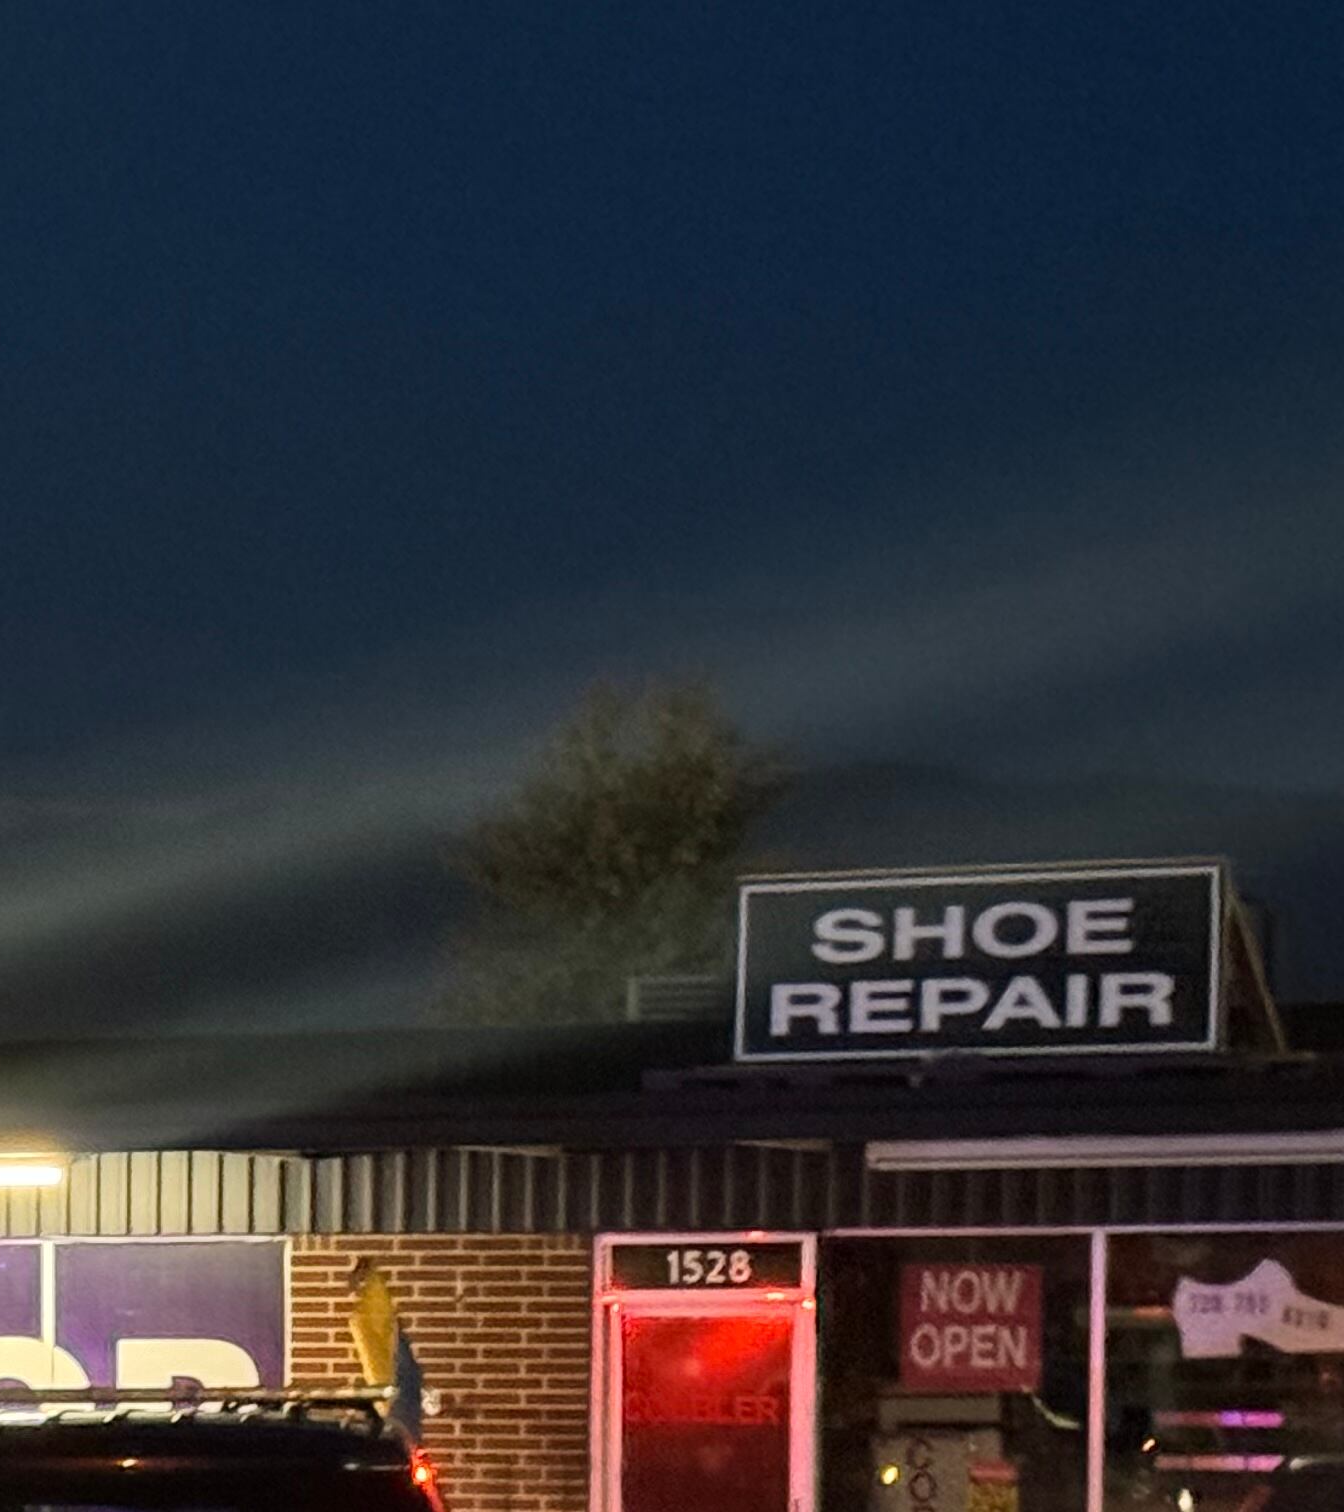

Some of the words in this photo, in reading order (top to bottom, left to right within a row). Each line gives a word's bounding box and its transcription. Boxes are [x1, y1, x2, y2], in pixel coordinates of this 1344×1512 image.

[812, 898, 1134, 963] SHOE
[769, 972, 1175, 1036] REPAIR
[667, 1249, 752, 1284] 1528
[920, 1270, 1024, 1313] NOW
[910, 1324, 1028, 1369] OPEN
